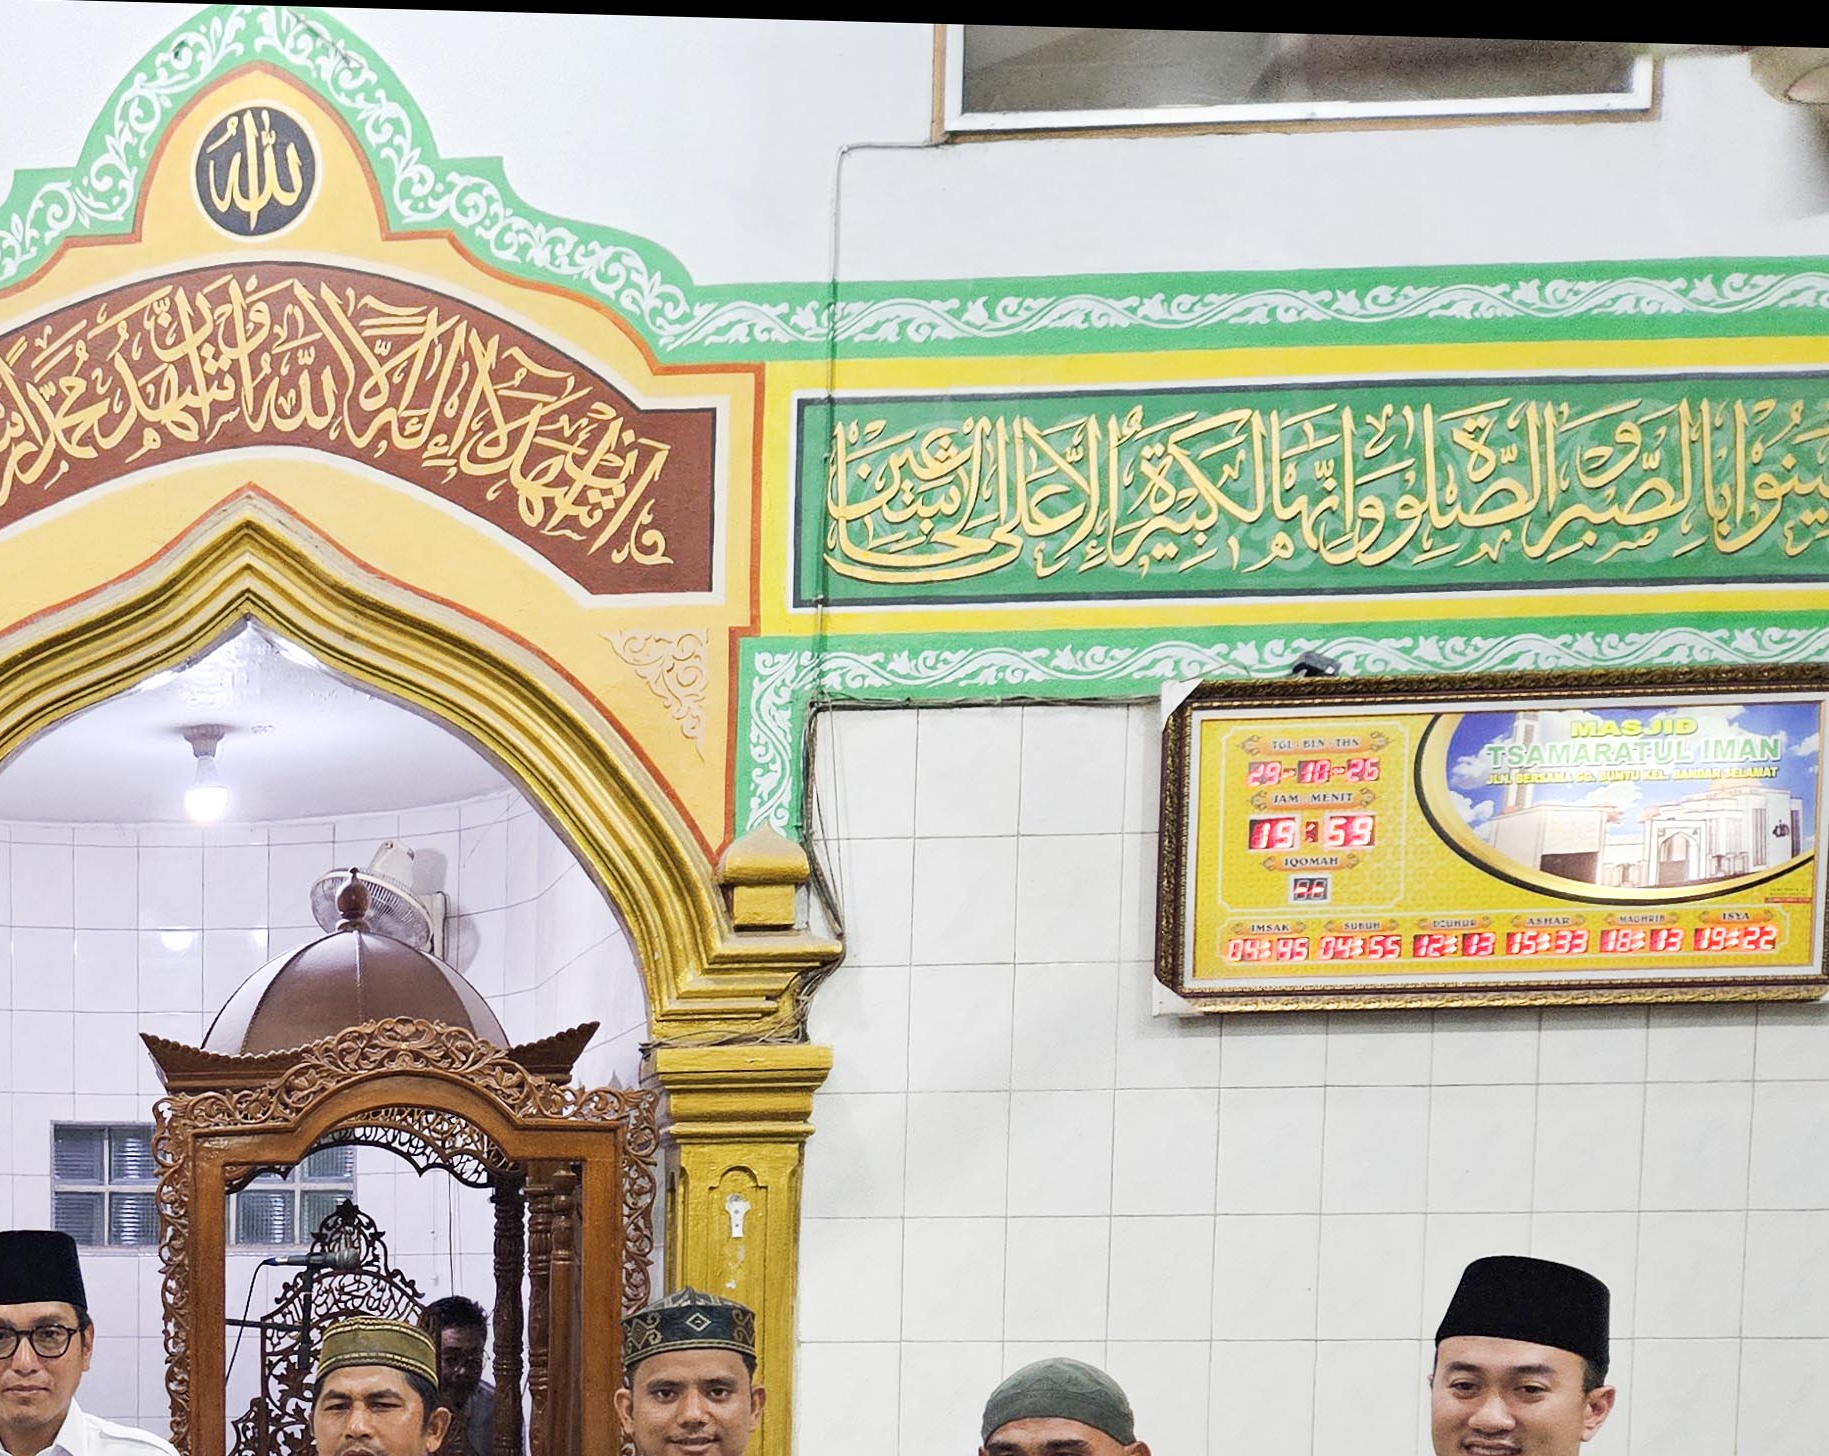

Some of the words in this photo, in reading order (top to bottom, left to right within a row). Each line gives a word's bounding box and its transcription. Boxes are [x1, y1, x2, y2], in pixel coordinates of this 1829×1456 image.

[1570, 718, 1698, 738] MASJID
[1487, 739, 1692, 769] TSAMARATUL
[1703, 736, 1782, 763] IMAN
[1274, 794, 1298, 803] JAM
[1311, 792, 1353, 802] MENIT
[1284, 857, 1338, 867] IQOMAH
[1251, 924, 1289, 932] IMSAK
[1527, 917, 1570, 926] ASHAR
[1722, 912, 1749, 921] ISYA
